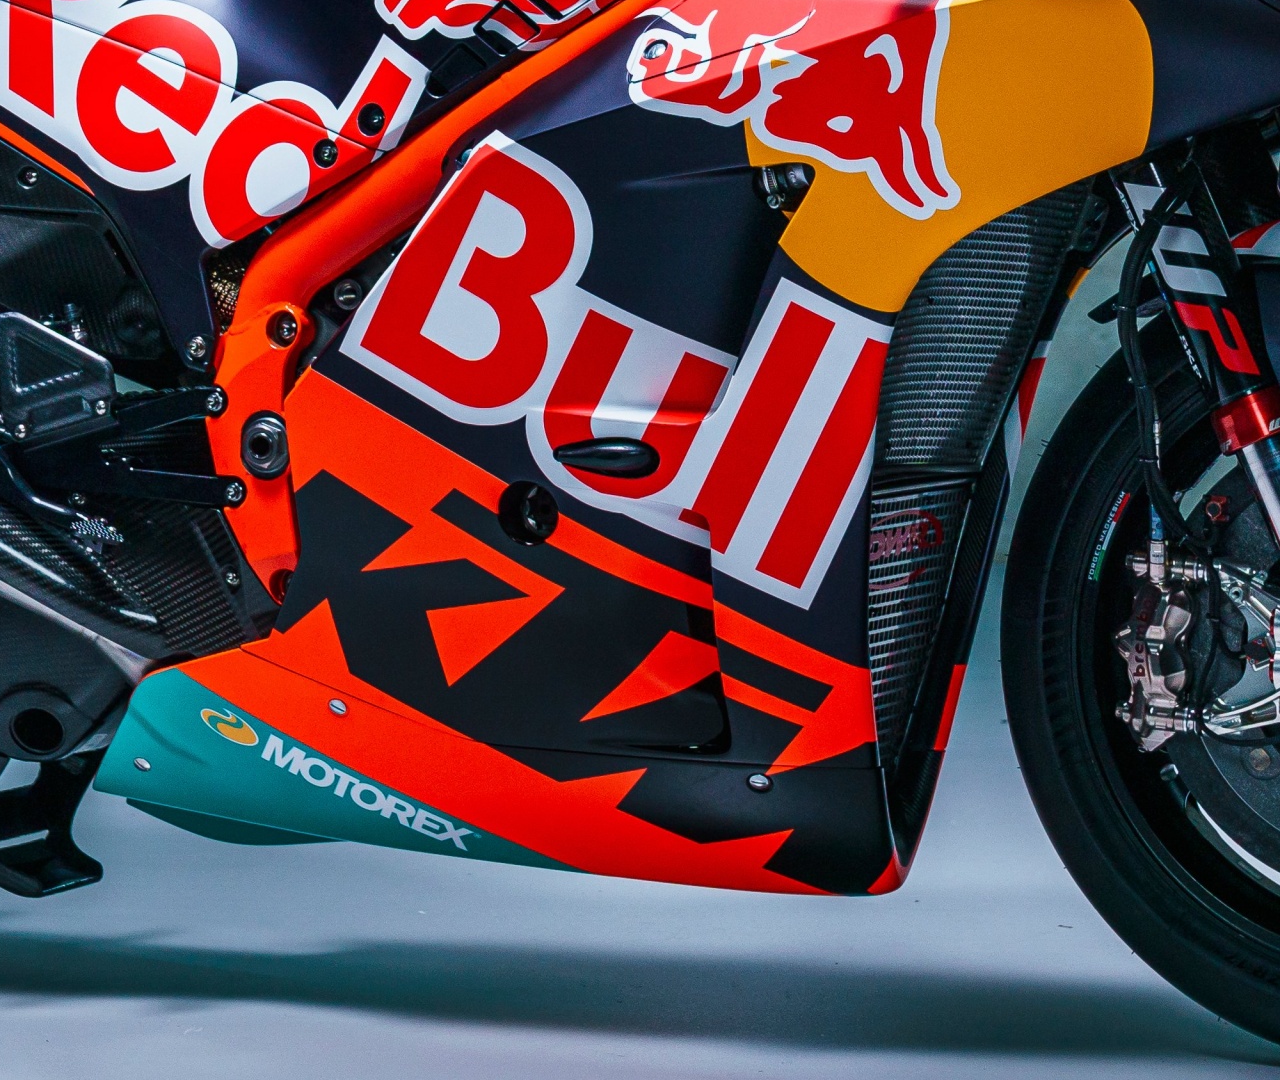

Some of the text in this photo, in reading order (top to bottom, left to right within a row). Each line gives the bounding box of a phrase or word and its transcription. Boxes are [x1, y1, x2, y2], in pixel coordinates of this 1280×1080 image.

[344, 135, 896, 605] Bull
[1087, 490, 1126, 581] FORGED MAGNESIUM
[261, 733, 473, 851] MOTOREX
